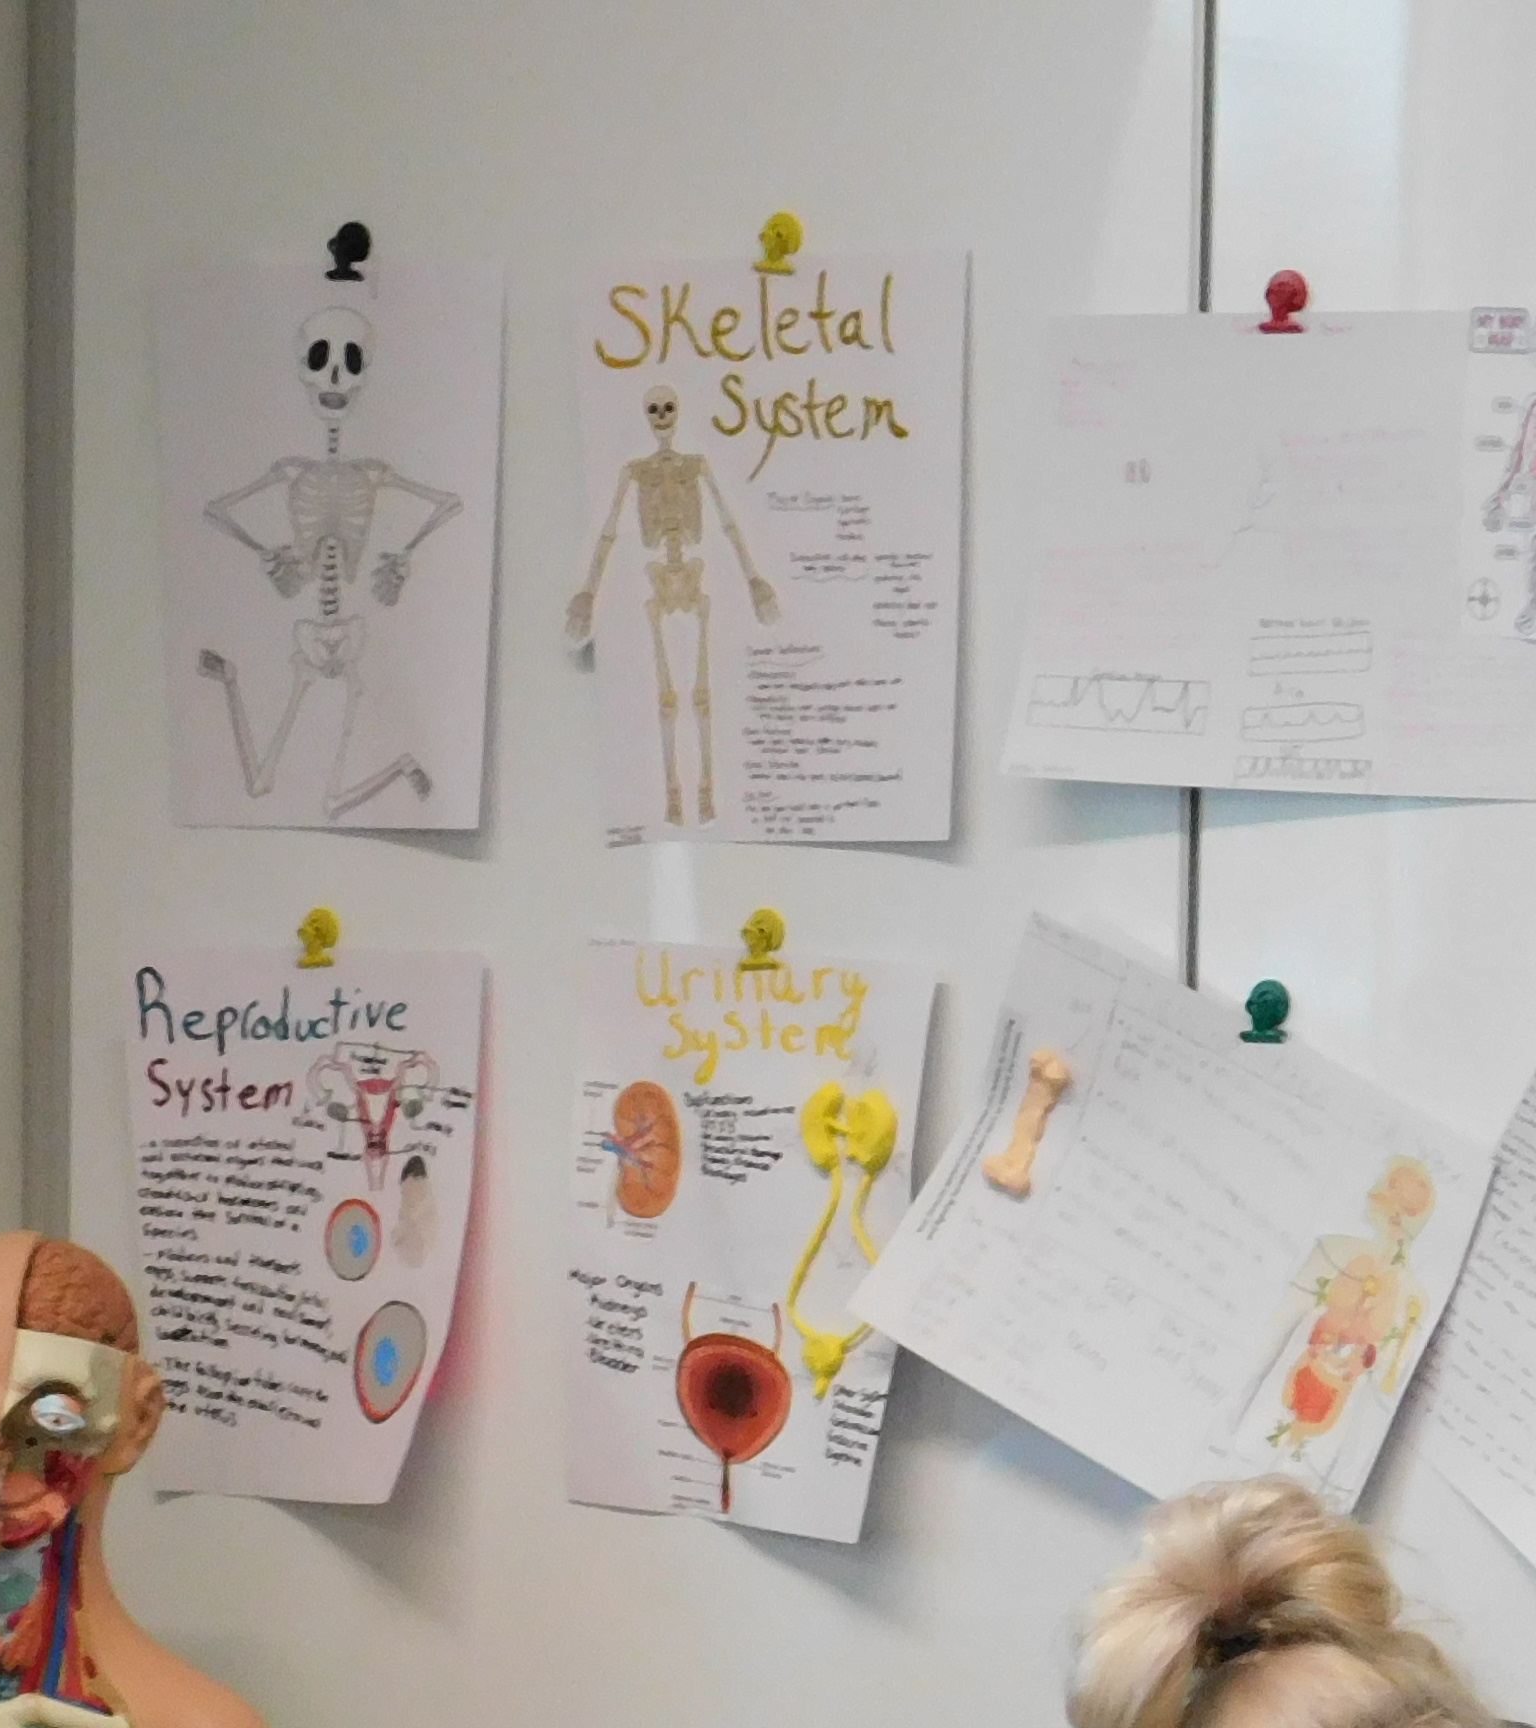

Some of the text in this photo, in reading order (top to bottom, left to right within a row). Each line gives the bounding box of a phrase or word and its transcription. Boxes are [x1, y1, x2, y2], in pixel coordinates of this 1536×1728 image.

[710, 375, 910, 484] System
[135, 965, 409, 1056] Reproductive
[147, 1058, 295, 1119] System
